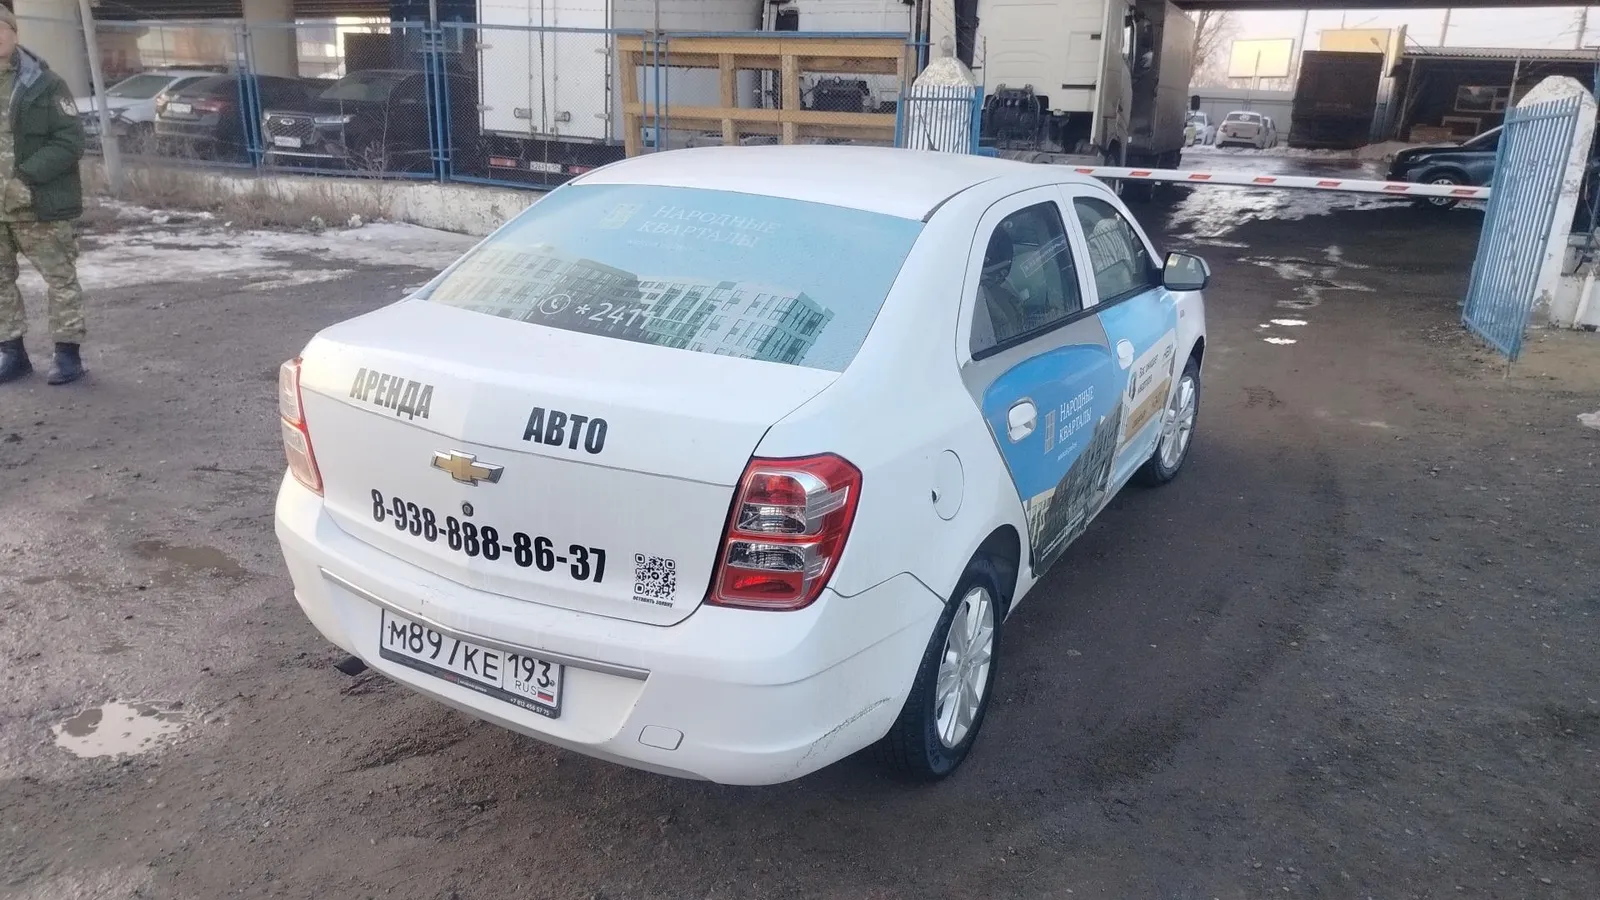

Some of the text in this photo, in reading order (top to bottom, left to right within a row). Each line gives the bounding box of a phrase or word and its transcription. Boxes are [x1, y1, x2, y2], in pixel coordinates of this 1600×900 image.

[636, 221, 760, 248] КВАРТАЛЫ
[349, 367, 608, 455] АРЕНДА АВТО
[371, 488, 607, 583] 8-938-888-86-37
[507, 653, 551, 688] 193
[514, 680, 537, 696] RUS
